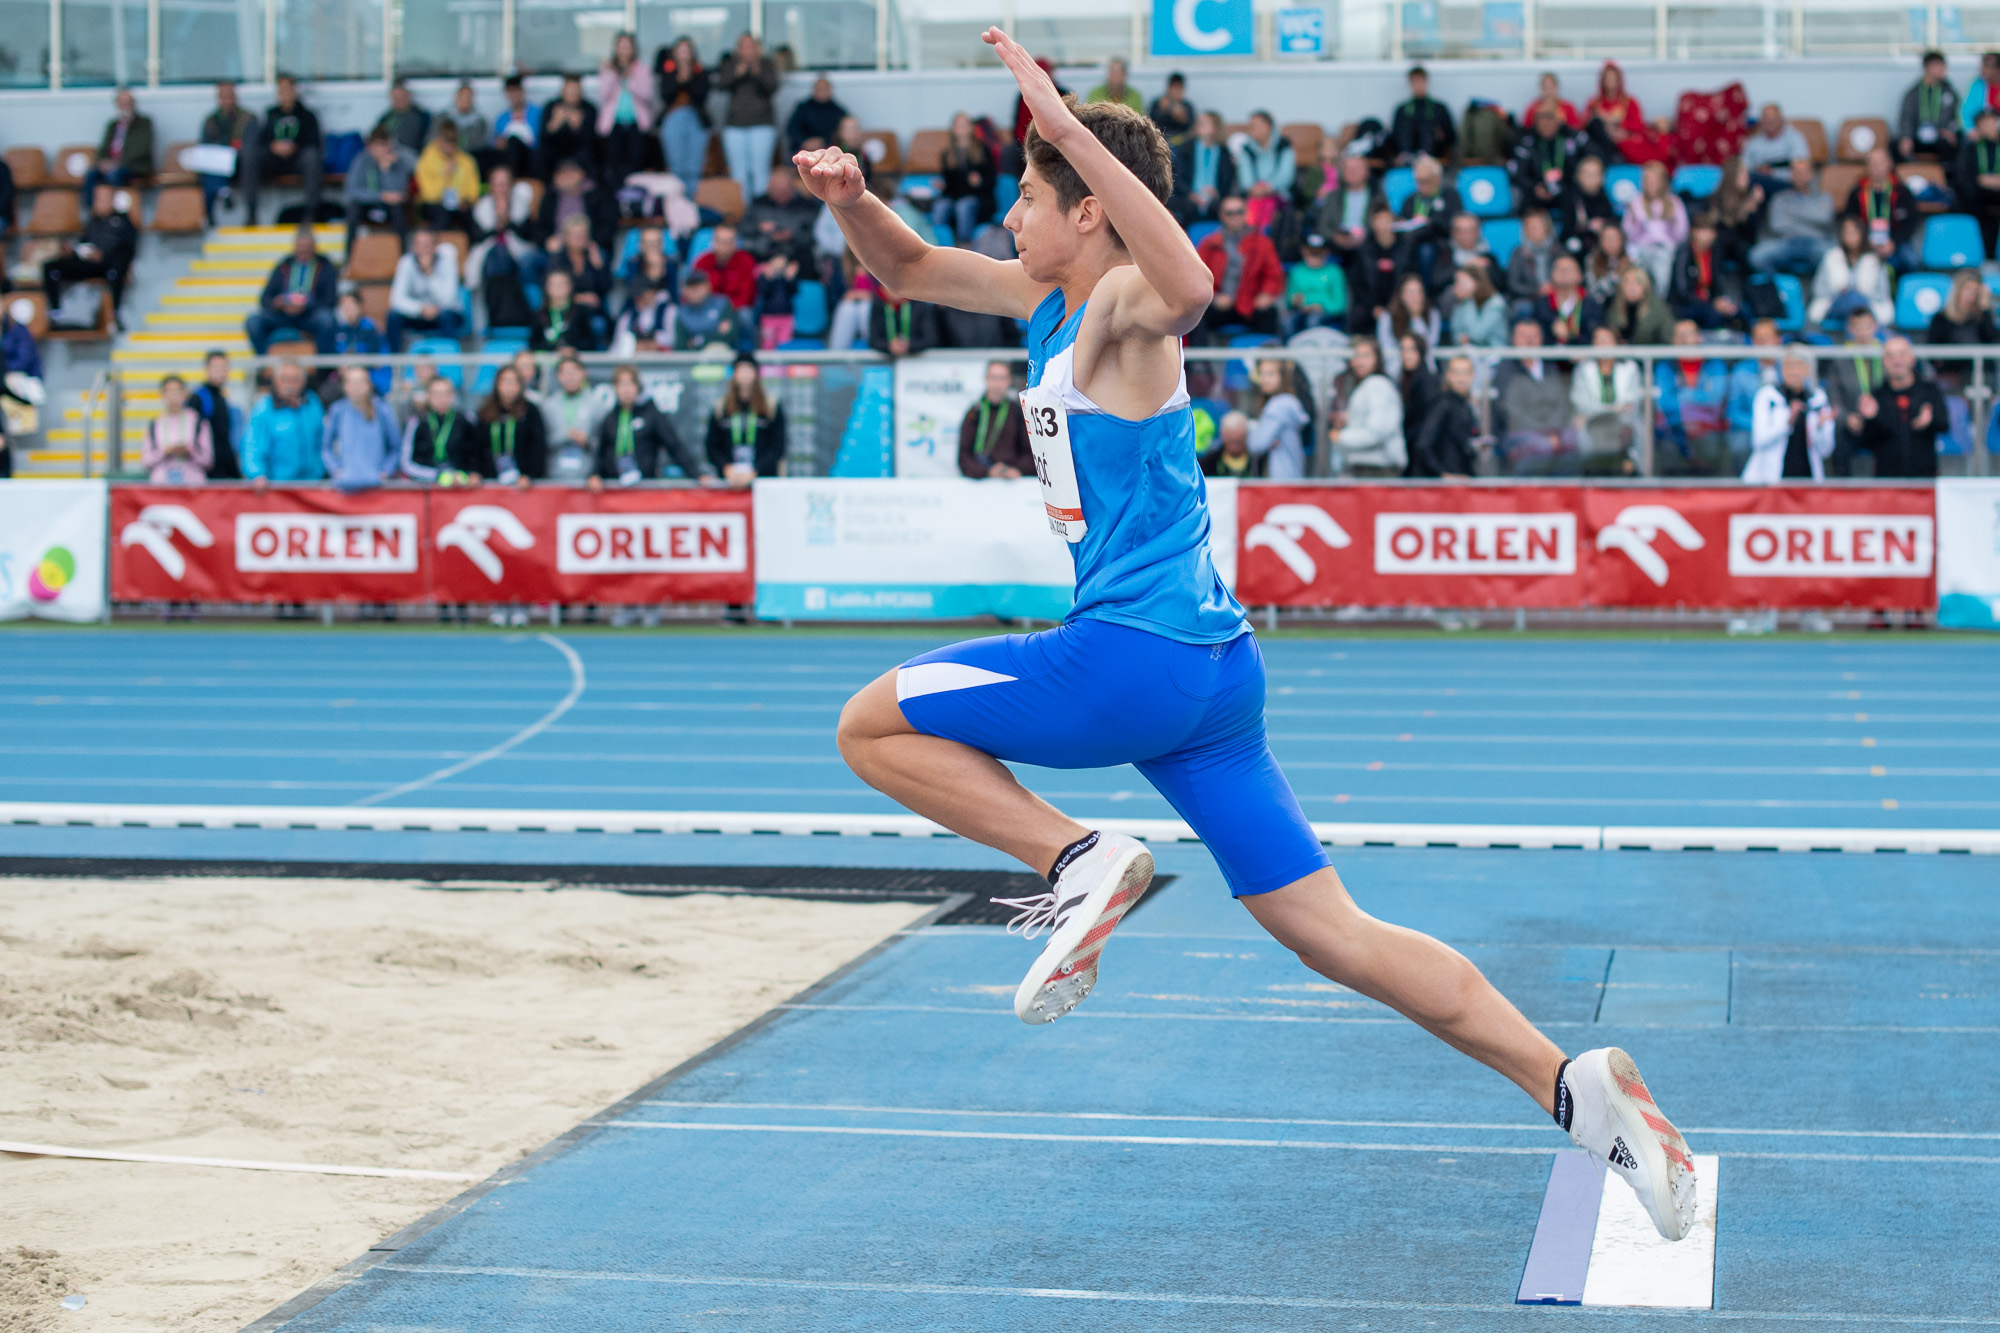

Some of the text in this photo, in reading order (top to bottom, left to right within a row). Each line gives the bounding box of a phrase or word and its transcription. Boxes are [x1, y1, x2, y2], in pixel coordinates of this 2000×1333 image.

[1172, 0, 1233, 51] C
[251, 525, 400, 558] ORLEN
[572, 525, 729, 560] ORLEN
[1390, 526, 1558, 561] ORLEN
[1744, 527, 1916, 563] ORLEN
[1614, 1135, 1638, 1170] adidas
